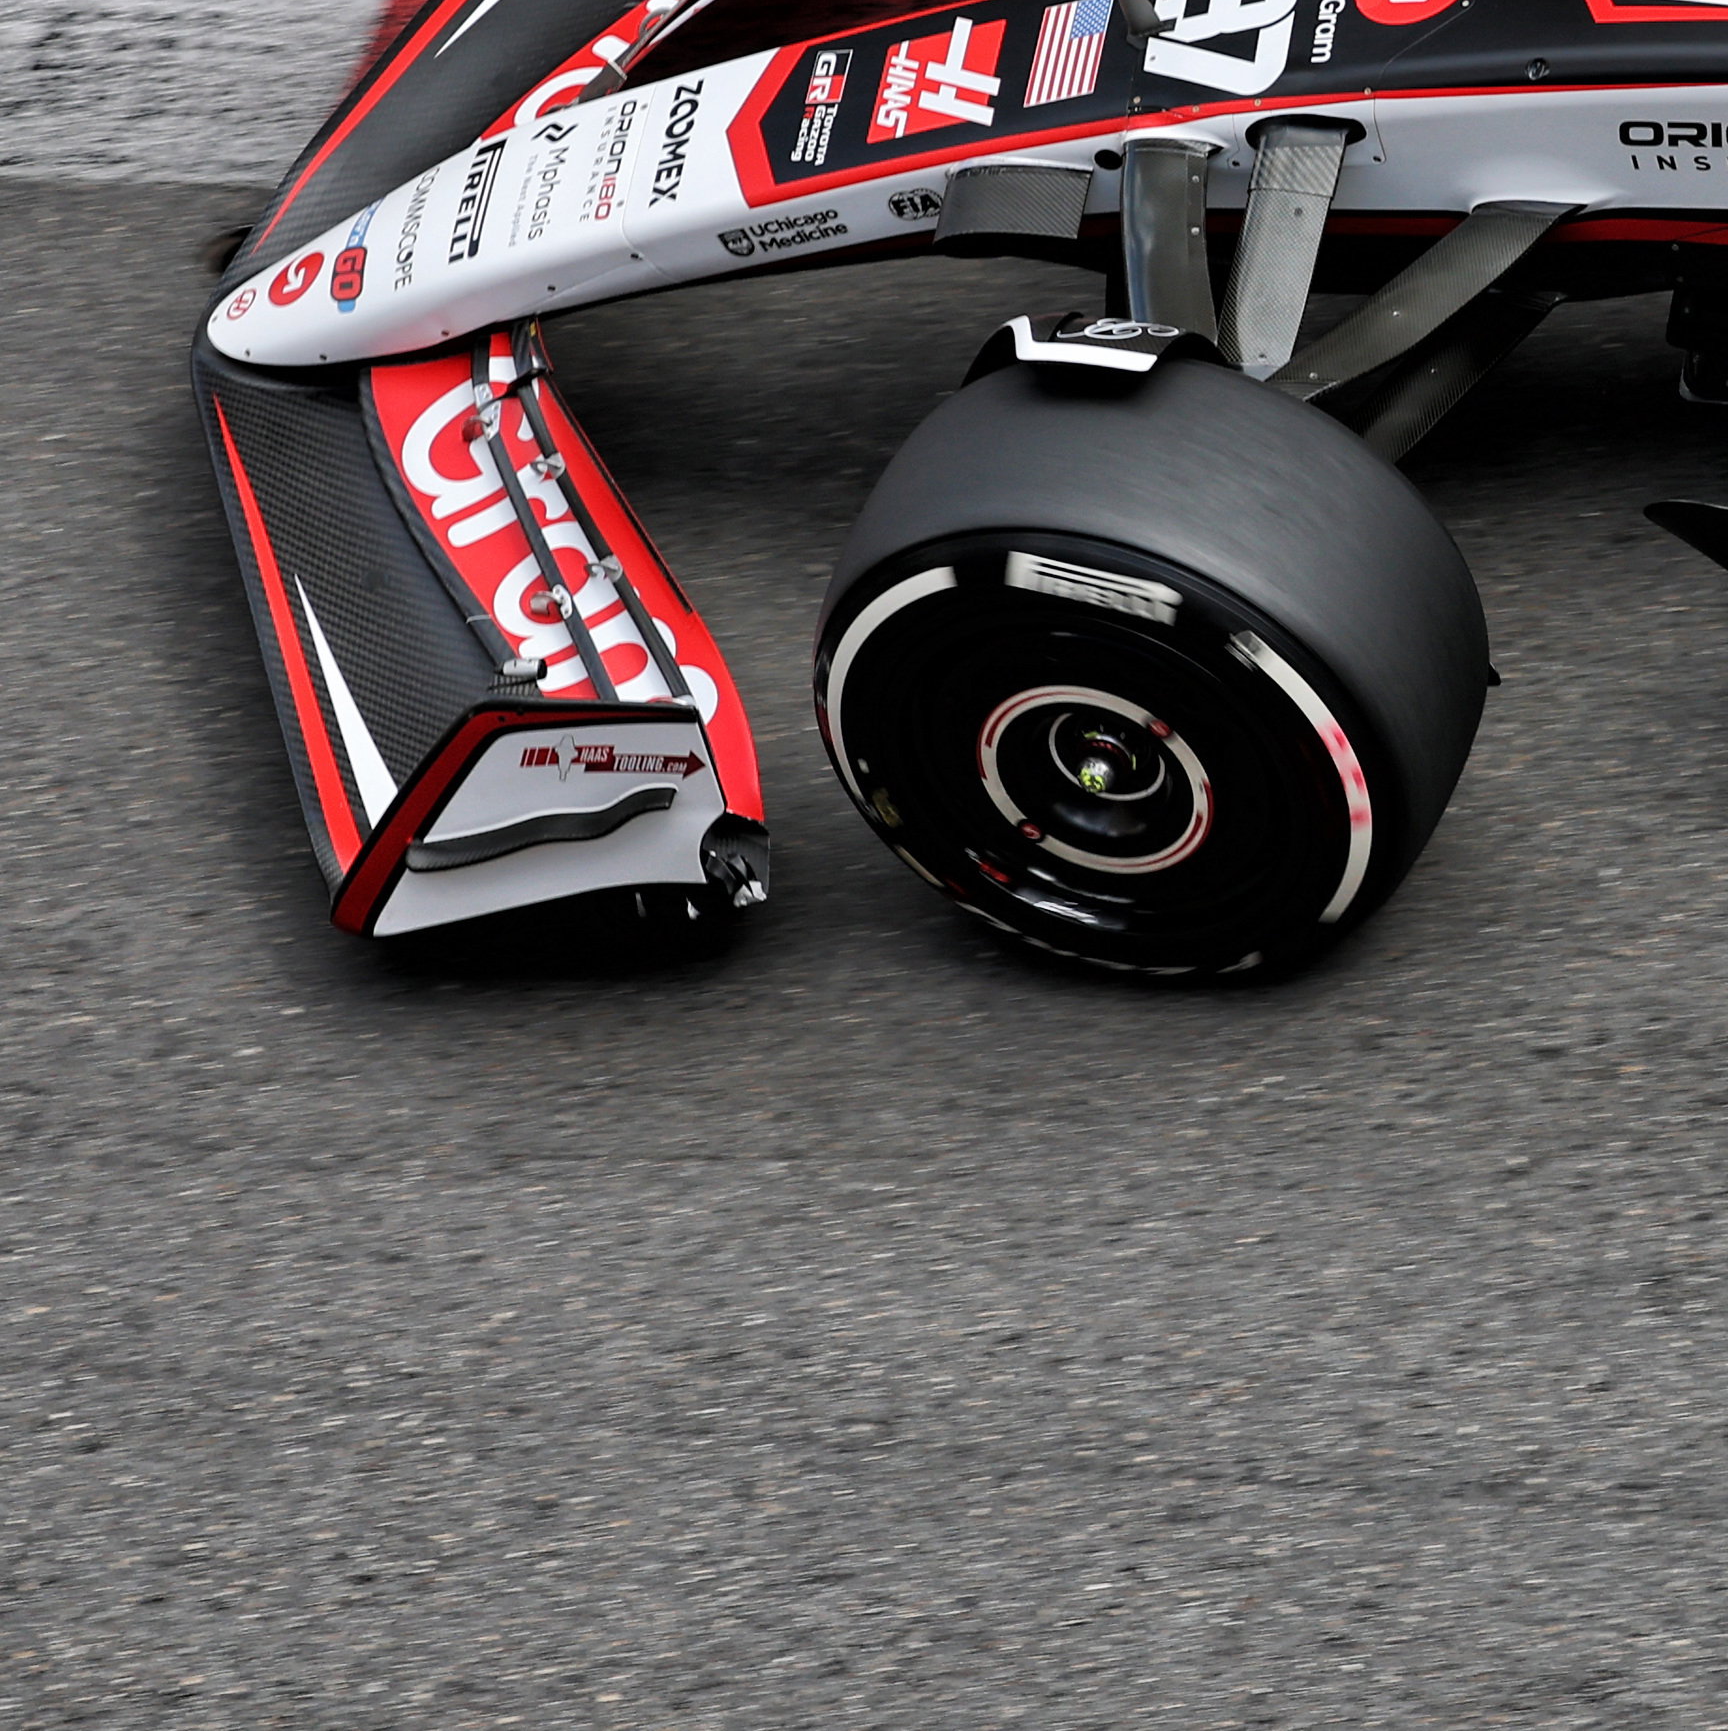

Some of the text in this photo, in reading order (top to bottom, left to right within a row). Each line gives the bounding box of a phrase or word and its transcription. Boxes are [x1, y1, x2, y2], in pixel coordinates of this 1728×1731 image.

[807, 52, 838, 102] GR
[594, 99, 638, 221] ORION180
[648, 78, 704, 209] ZOOMEX
[791, 106, 815, 163] Racing
[804, 105, 826, 163] GAZOO
[814, 104, 839, 167] TOYOTA
[579, 106, 617, 223] INSURANCE
[447, 137, 508, 265] PIRELLI
[527, 146, 570, 242] Mphasis
[749, 208, 839, 238] UChicago
[758, 222, 849, 253] Medicine
[331, 246, 368, 302] GO
[579, 746, 610, 763] HAAS
